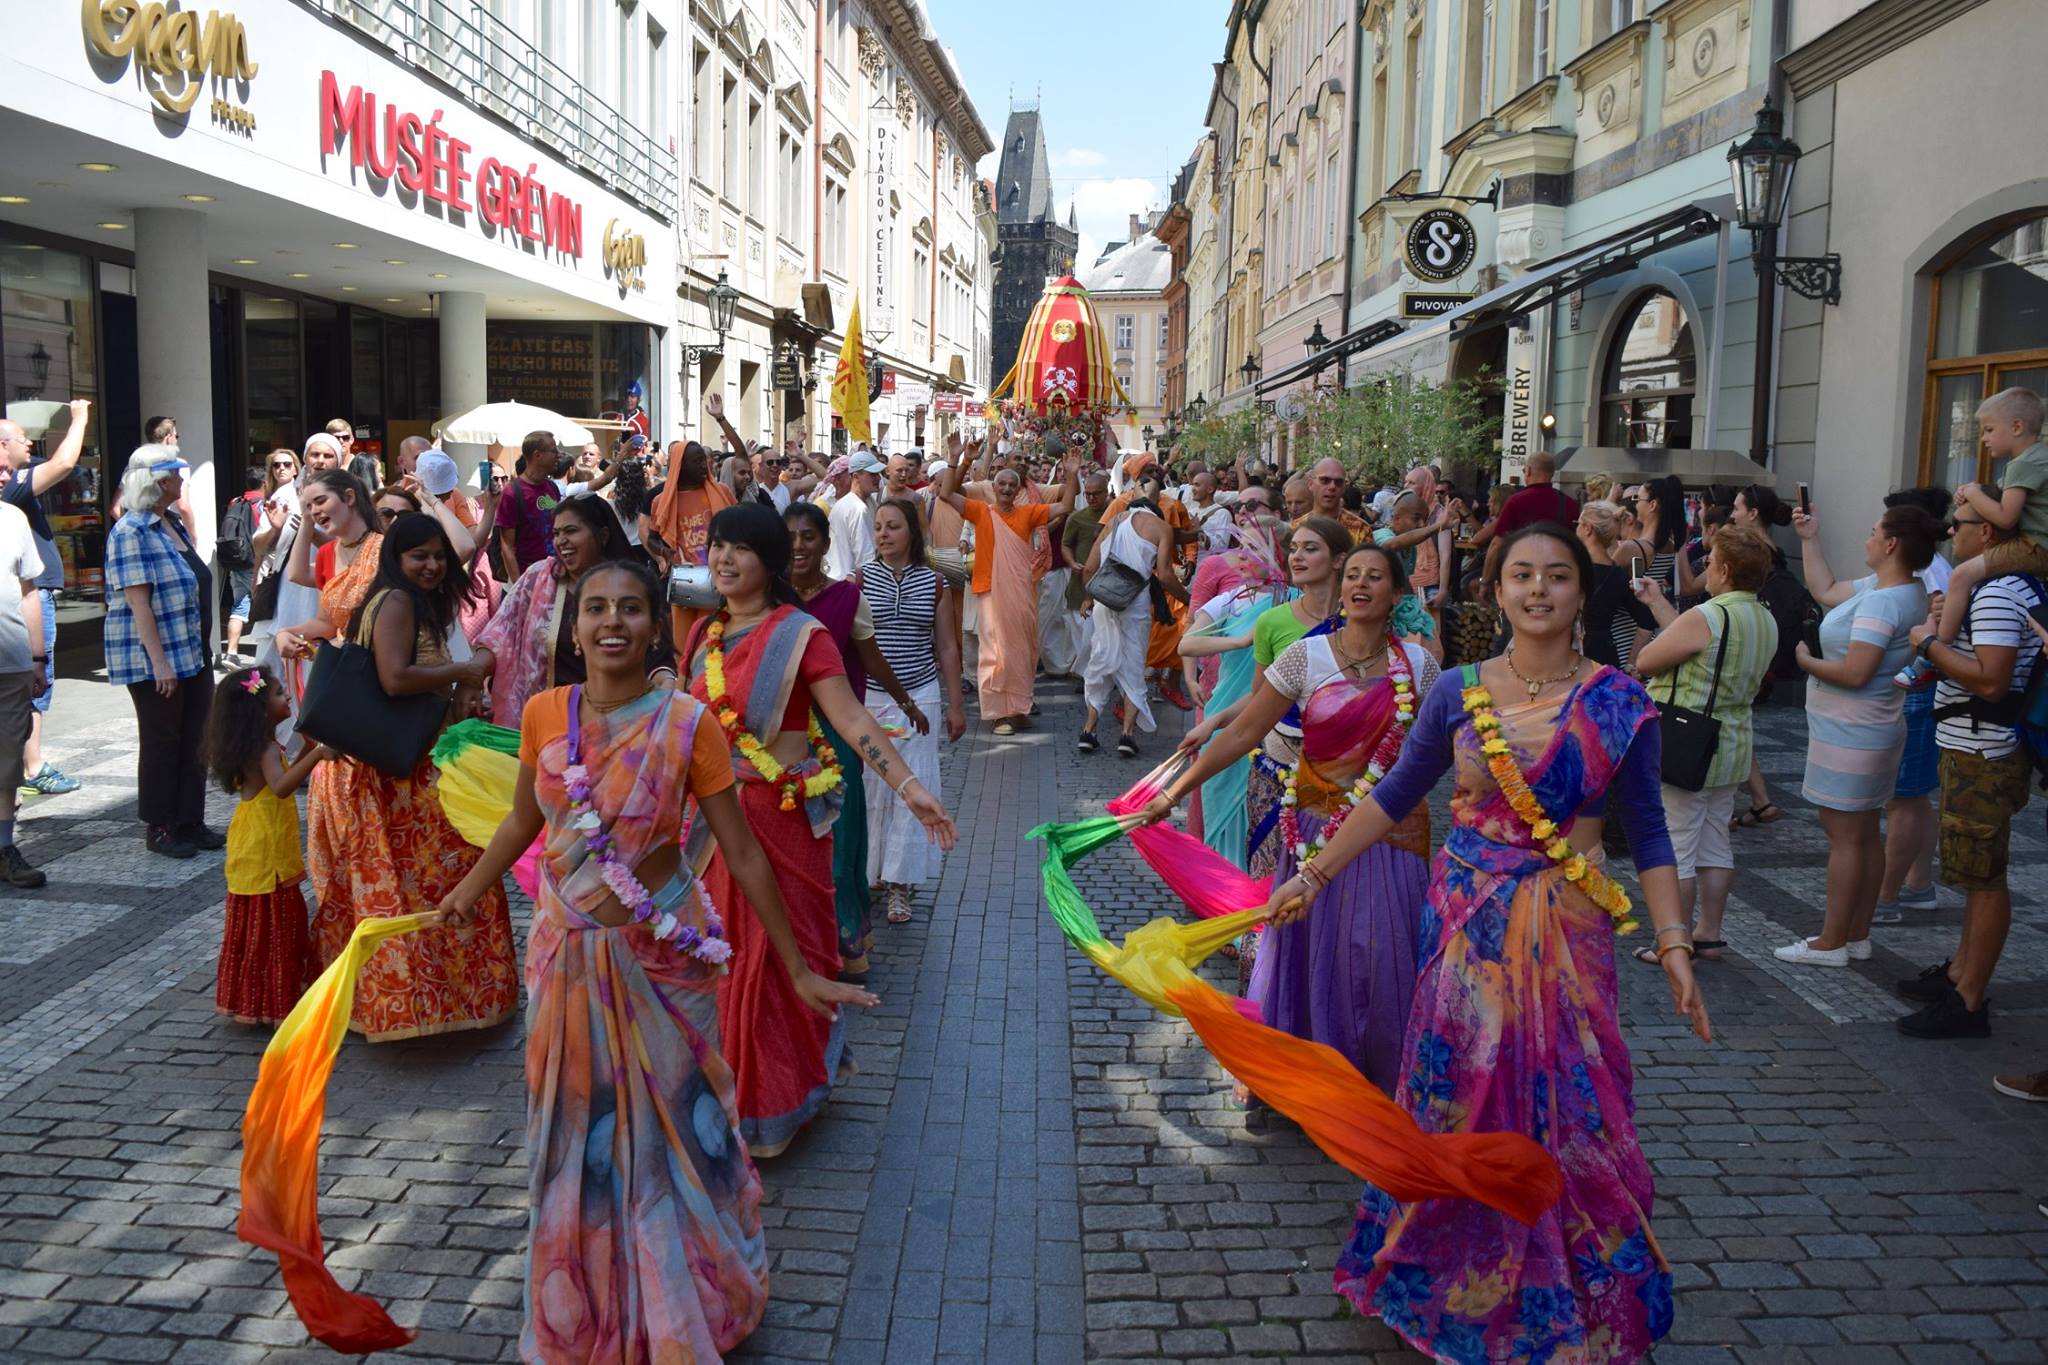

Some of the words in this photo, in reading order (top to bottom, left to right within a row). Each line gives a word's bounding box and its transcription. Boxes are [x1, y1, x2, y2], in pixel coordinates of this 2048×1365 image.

[211, 97, 257, 131] PRAHA
[321, 70, 473, 214] MUSÉE
[476, 156, 583, 259] GRÉVIN
[877, 127, 886, 208] DIVADLO
[1466, 229, 1475, 249] TOWN
[1511, 367, 1531, 456] BREWERY
